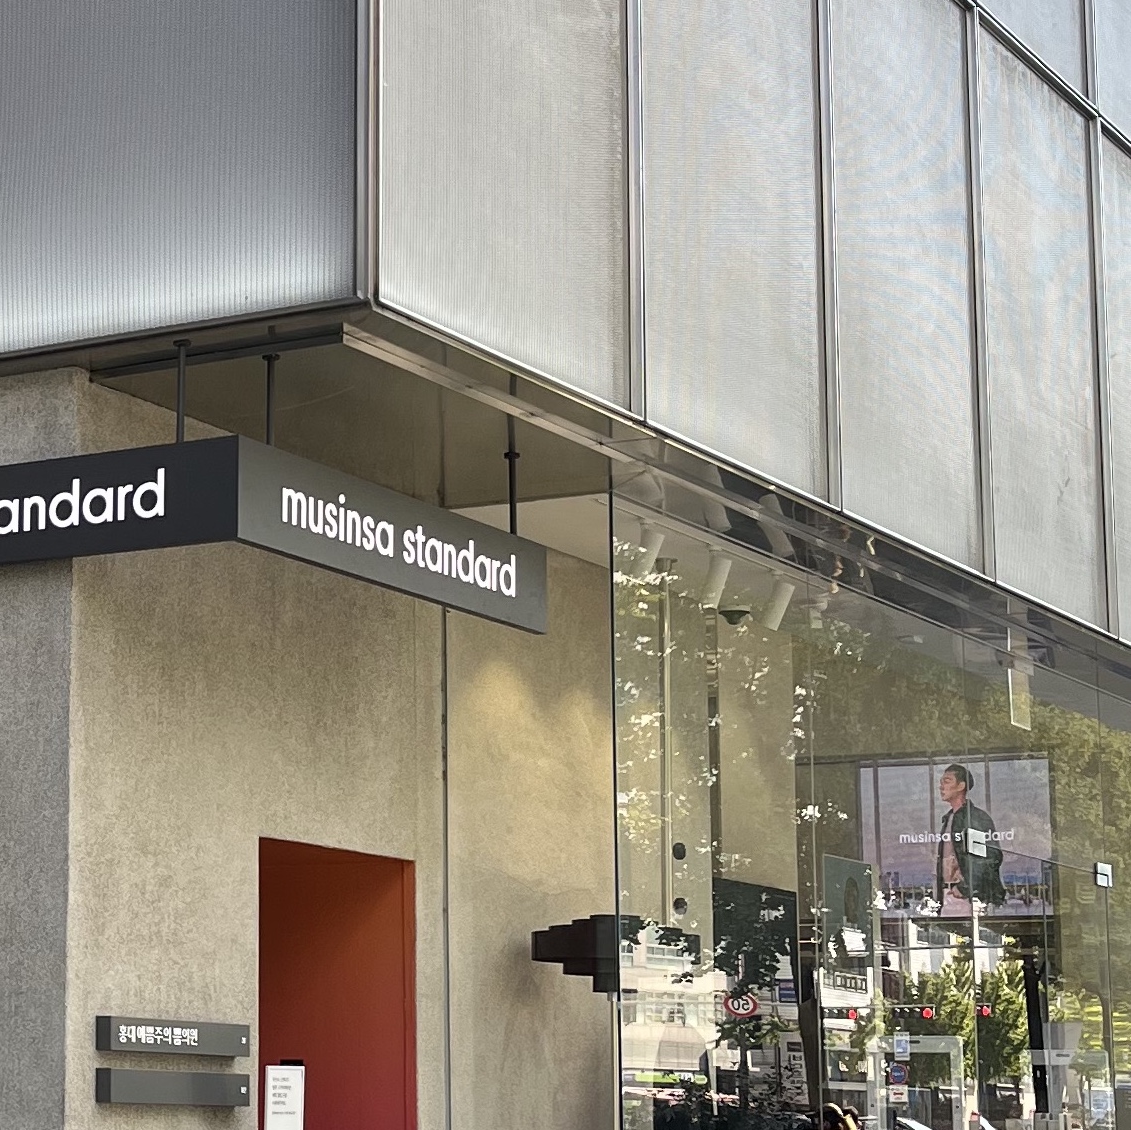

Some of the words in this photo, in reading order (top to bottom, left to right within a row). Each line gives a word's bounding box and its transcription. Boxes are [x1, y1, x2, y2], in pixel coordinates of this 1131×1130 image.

[282, 487, 394, 558] musinsa
[402, 525, 516, 598] standard
[899, 831, 951, 844] musinsa
[954, 828, 1015, 842] stdard
